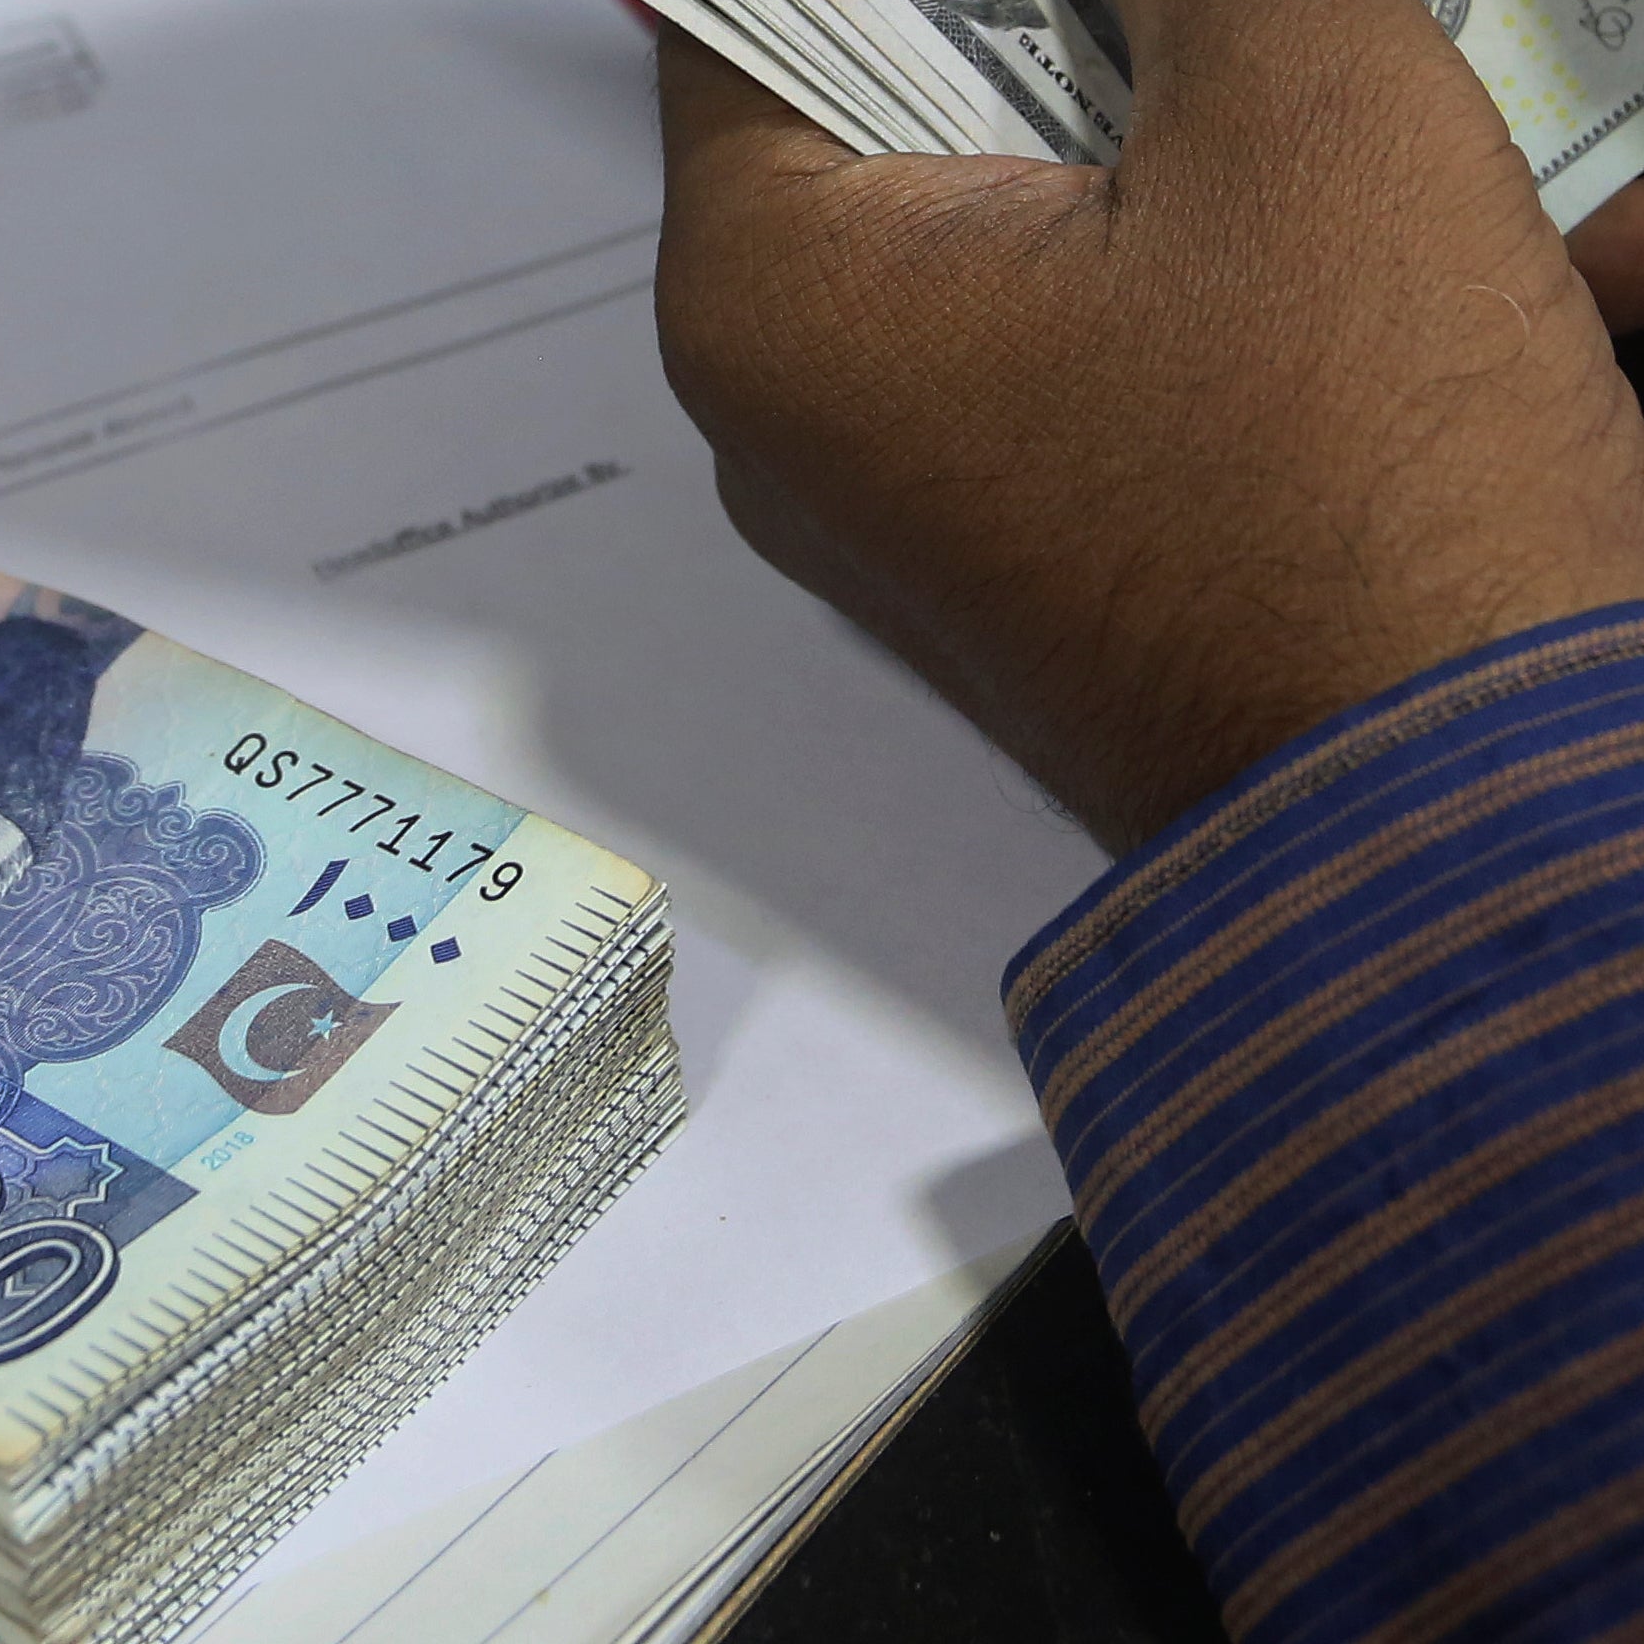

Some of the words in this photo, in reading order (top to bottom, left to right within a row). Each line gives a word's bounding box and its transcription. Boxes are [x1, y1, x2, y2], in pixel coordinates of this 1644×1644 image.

[1015, 32, 1096, 114] NOTE
[222, 733, 524, 902] QS7771179
[201, 1131, 255, 1172] 2018
